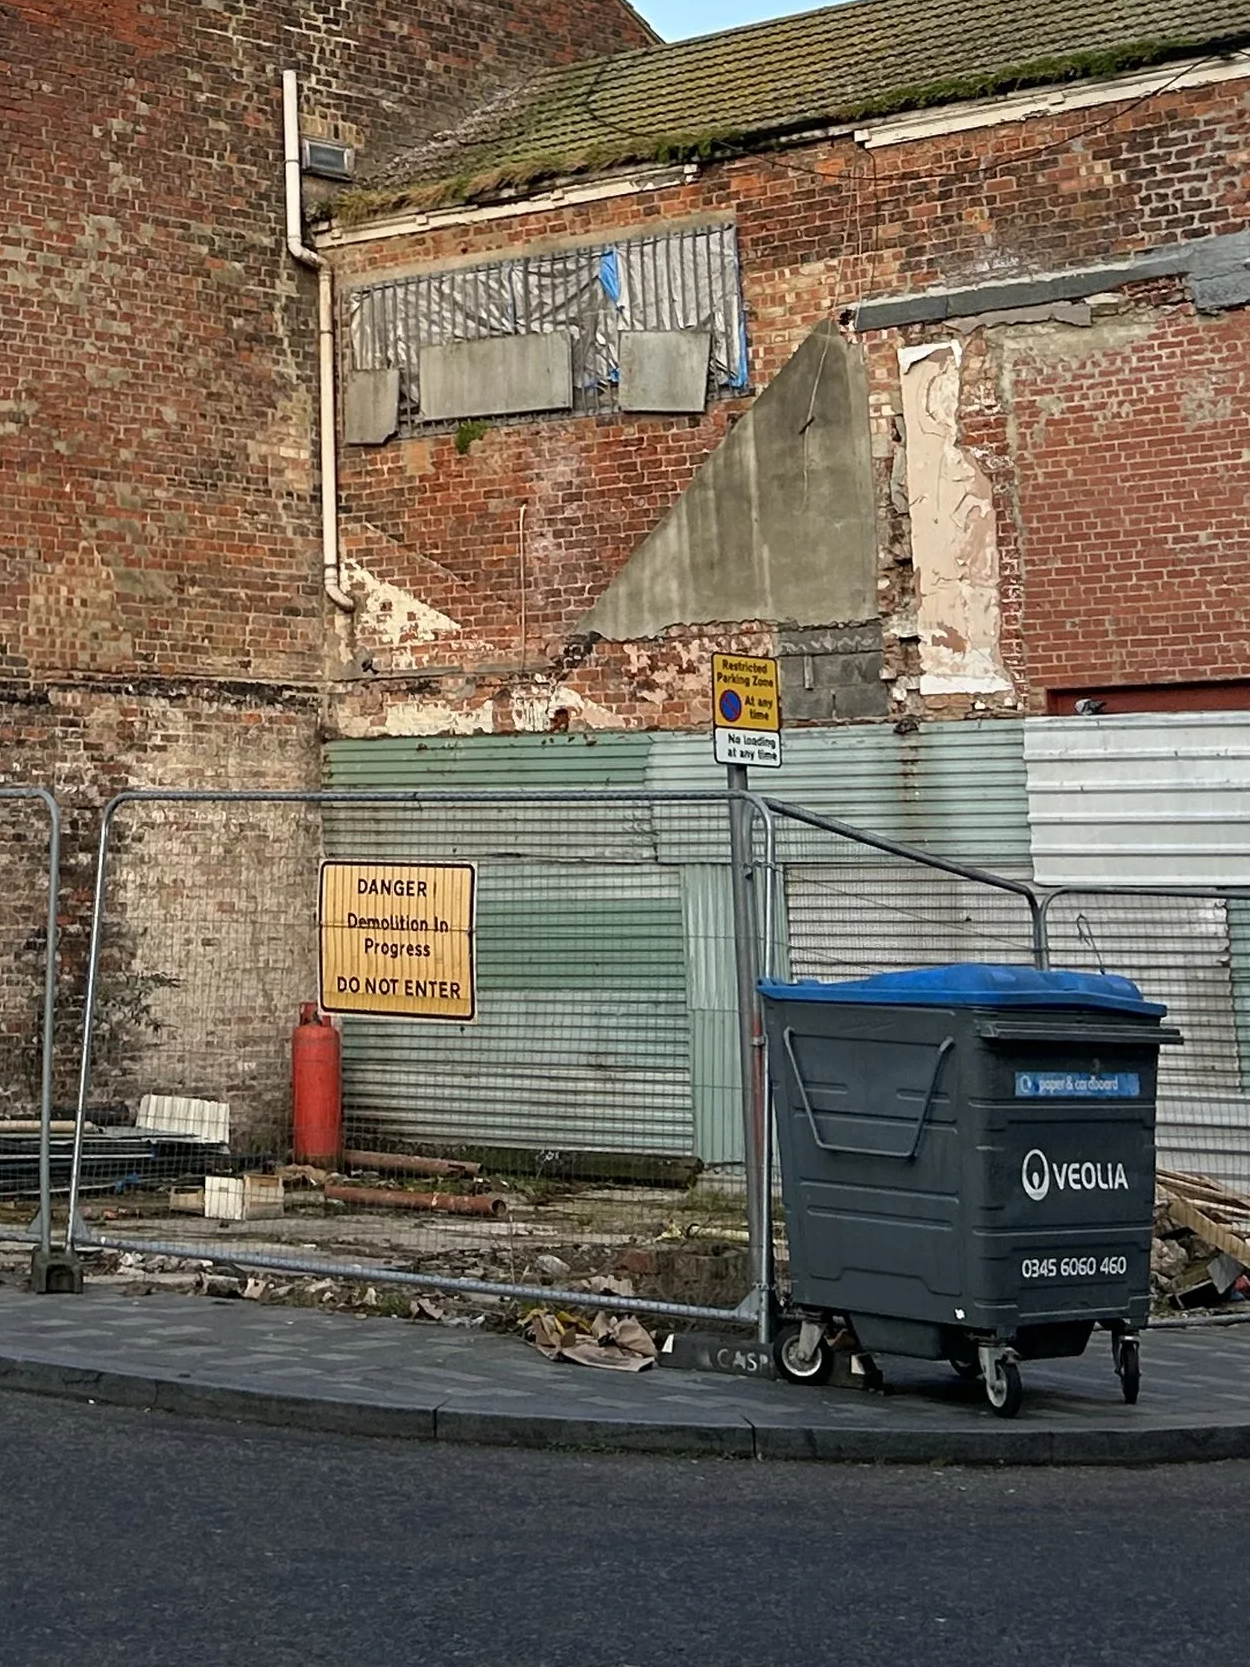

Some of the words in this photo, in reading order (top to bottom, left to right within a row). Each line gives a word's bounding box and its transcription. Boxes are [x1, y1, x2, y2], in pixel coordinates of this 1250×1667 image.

[722, 659, 767, 674] Restricted
[717, 672, 750, 687] Parking
[752, 675, 773, 687] Zone
[744, 695, 755, 707] At
[758, 698, 773, 709] any
[749, 709, 769, 720] time
[728, 734, 741, 744] No
[743, 734, 775, 749] loading
[728, 748, 737, 757] at
[739, 749, 755, 760] any
[757, 749, 777, 761] time
[357, 878, 427, 897] DANGER
[347, 912, 428, 932] Demolition
[434, 916, 449, 933] In
[364, 937, 431, 958] Progress
[337, 976, 360, 994] DO
[365, 978, 399, 995] NOT
[404, 980, 461, 999] ENTER
[1038, 1078, 1065, 1094] paper
[1066, 1075, 1073, 1090] &
[1052, 1162, 1129, 1190] VEOLIA
[1021, 1259, 1057, 1278] 0345
[1060, 1257, 1096, 1276] 6060
[1099, 1256, 1127, 1275] 460
